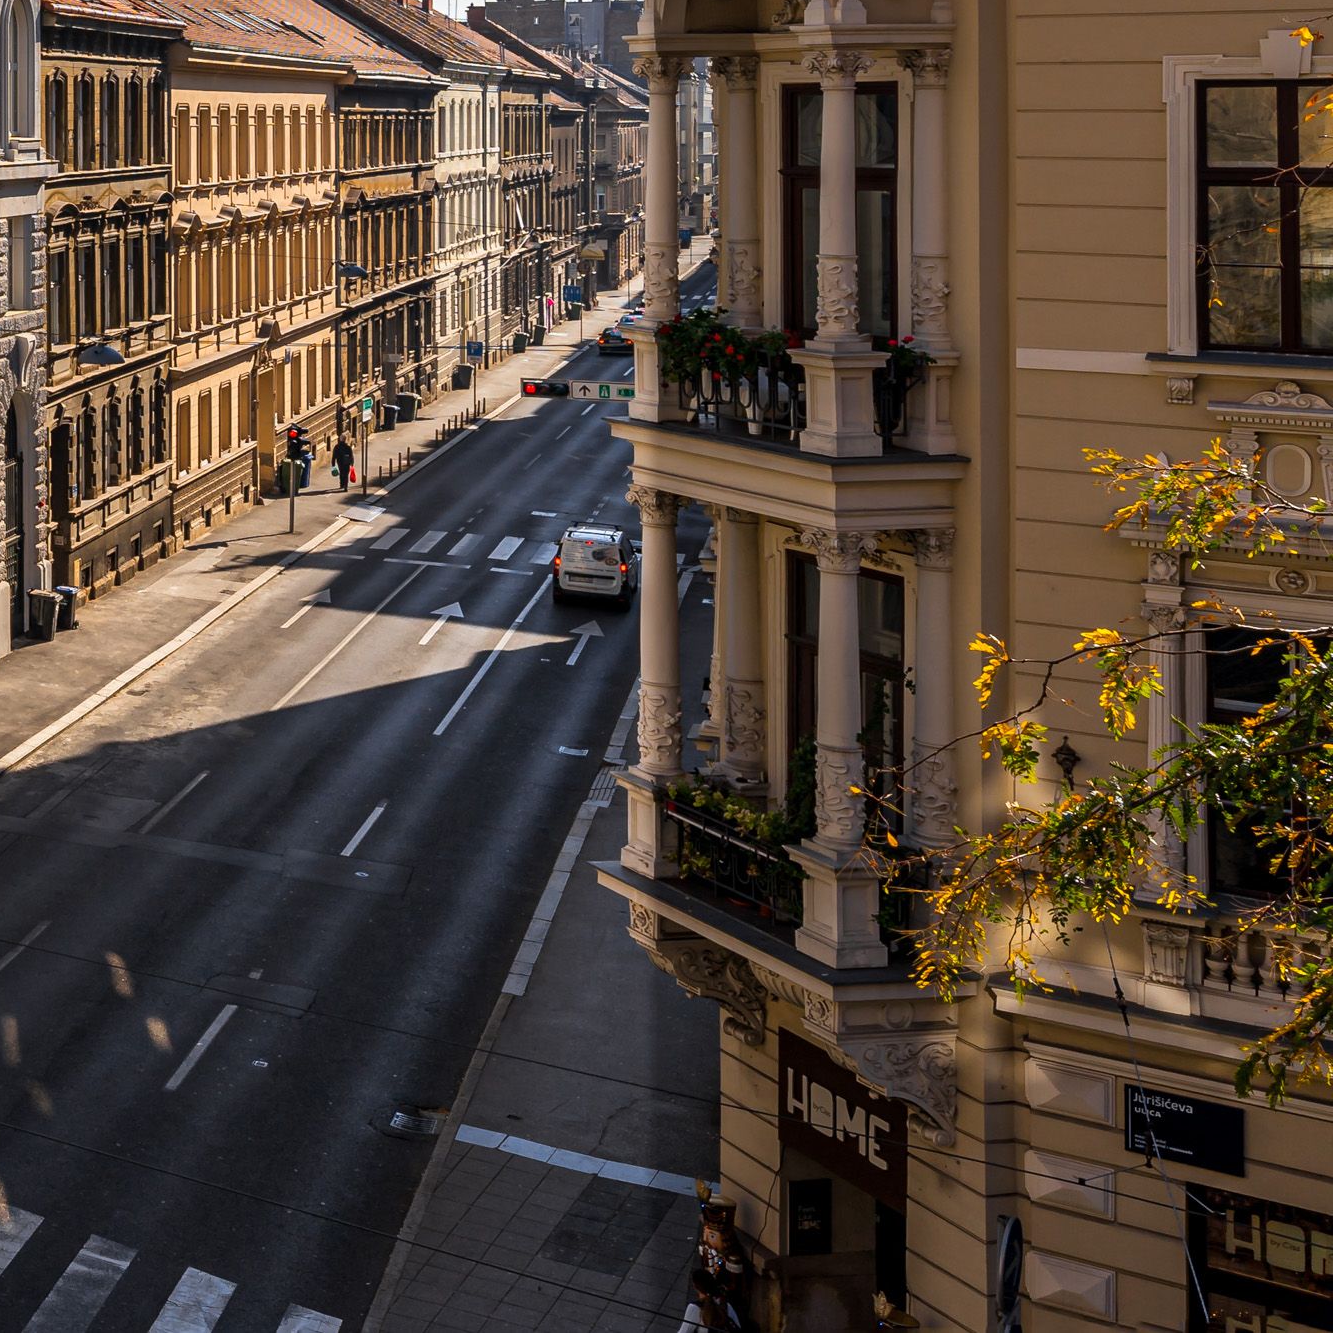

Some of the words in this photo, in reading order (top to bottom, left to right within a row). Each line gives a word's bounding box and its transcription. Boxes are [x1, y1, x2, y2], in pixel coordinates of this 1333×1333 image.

[1133, 1092, 1193, 1114] Jurišićeva
[1134, 1106, 1162, 1118] ULCA
[787, 1066, 890, 1171] HOME
